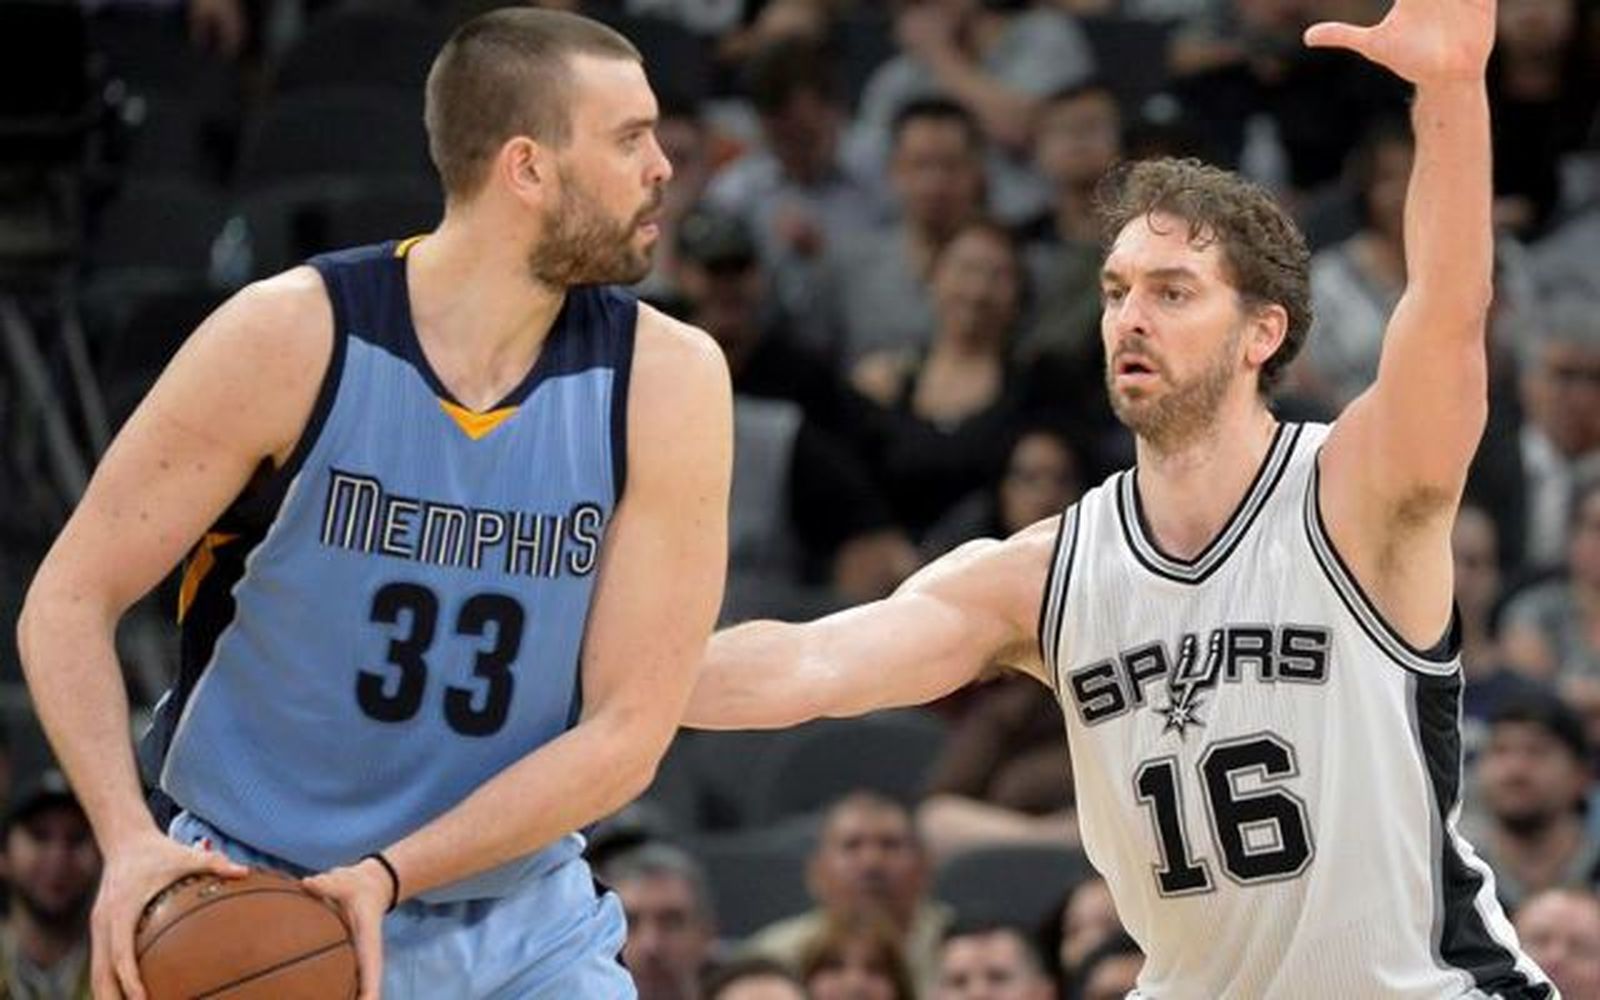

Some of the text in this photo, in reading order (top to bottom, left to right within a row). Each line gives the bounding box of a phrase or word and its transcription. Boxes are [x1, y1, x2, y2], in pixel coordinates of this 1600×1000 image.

[320, 468, 603, 578] MEMPHIS
[355, 582, 526, 737] 33
[1068, 623, 1332, 740] SPURS
[1132, 730, 1316, 898] 16
